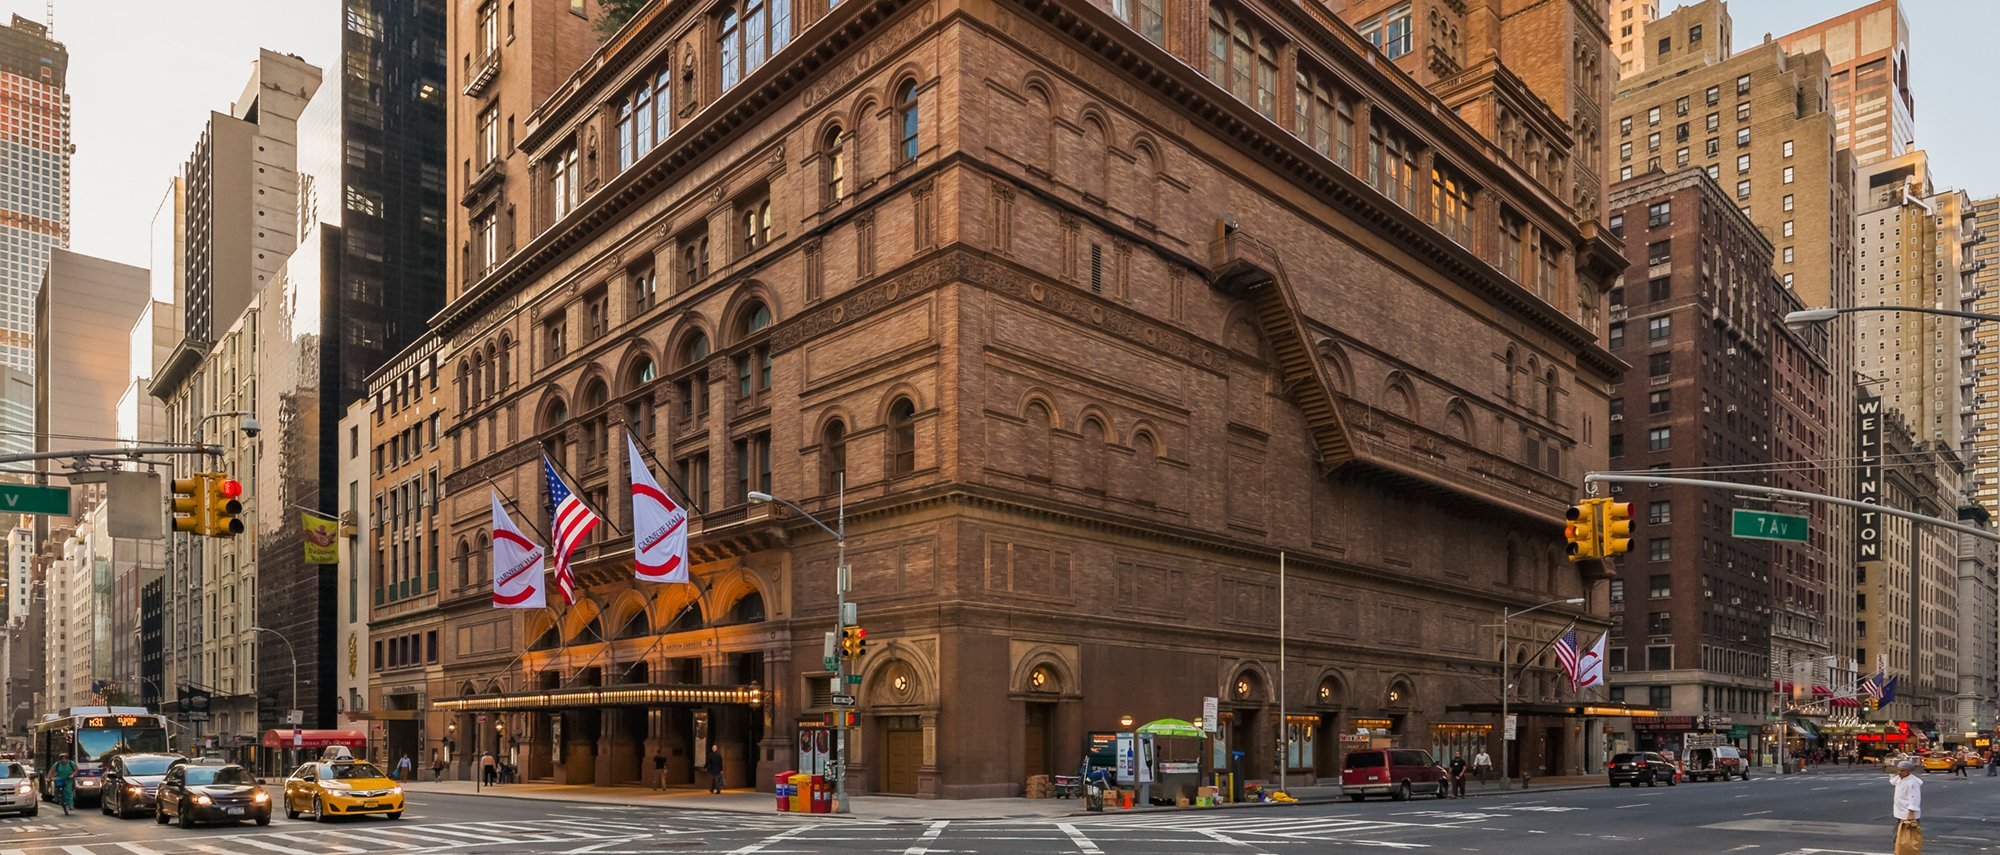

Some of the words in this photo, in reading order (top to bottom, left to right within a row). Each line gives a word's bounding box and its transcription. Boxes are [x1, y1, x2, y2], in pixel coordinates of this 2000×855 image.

[1858, 400, 1879, 556] WELLINGTON
[1757, 517, 1766, 533] 7
[637, 524, 668, 550] CARNEGIE
[495, 562, 526, 584] CARNEGIE
[89, 717, 104, 727] M31
